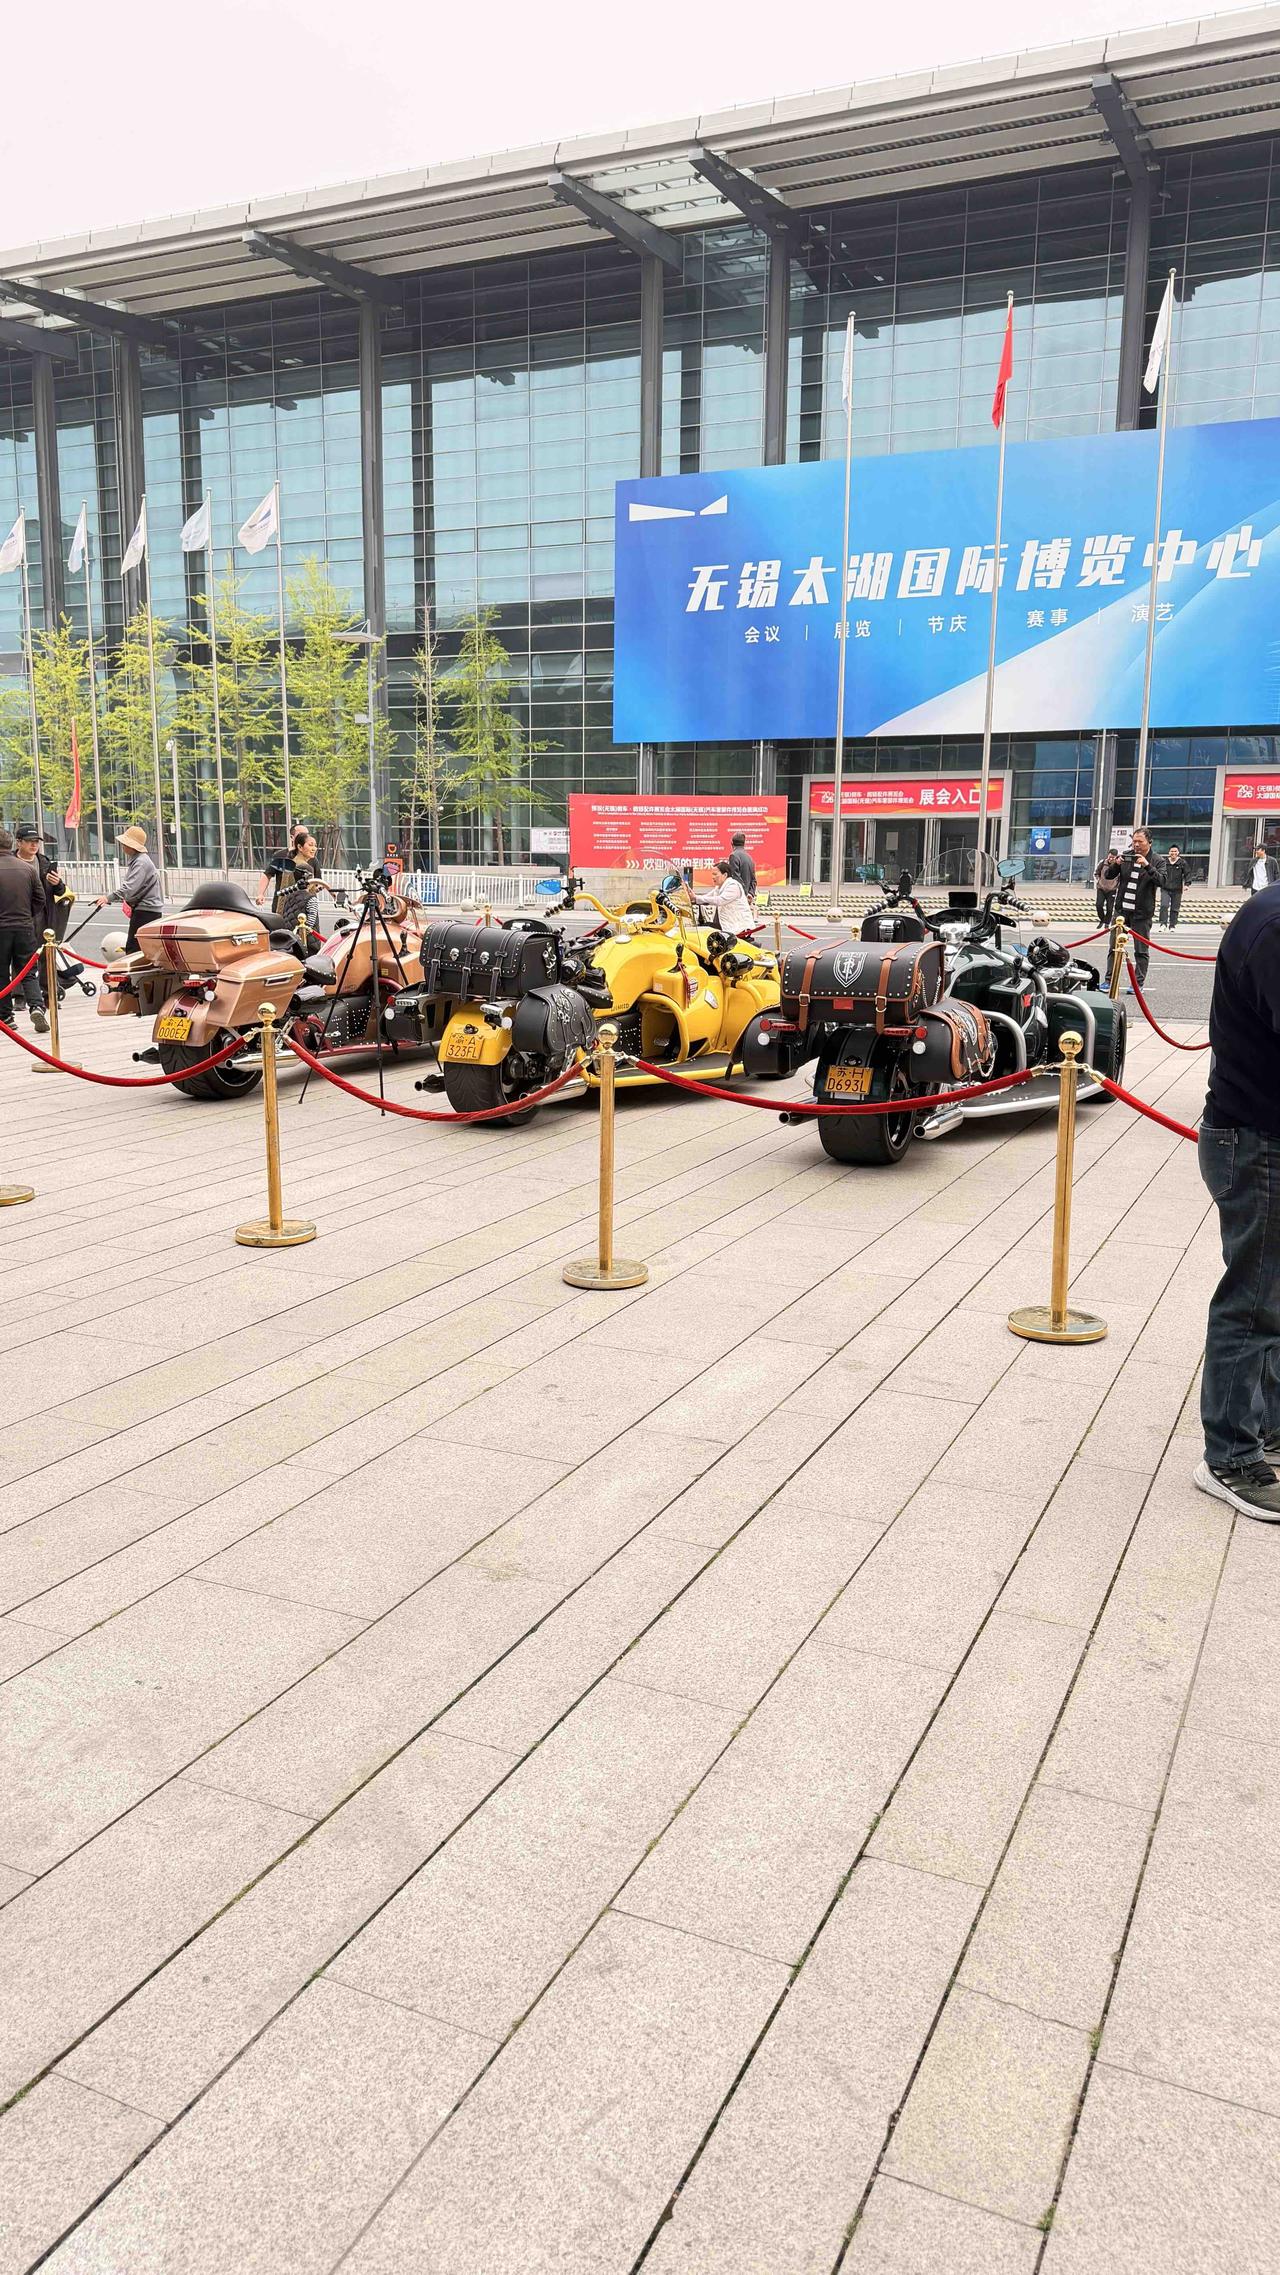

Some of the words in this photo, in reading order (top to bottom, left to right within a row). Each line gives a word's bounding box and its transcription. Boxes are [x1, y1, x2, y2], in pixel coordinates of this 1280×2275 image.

[684, 525, 1264, 613] 无锡太湖国际博览中心
[744, 625, 781, 644] 会议
[833, 619, 872, 639] 展览
[927, 614, 967, 634] 节庆
[1026, 608, 1069, 628] 赛事
[1130, 602, 1175, 623] 演艺
[918, 787, 981, 805] 展会入口
[158, 1027, 187, 1040] 000EZ
[447, 1044, 477, 1059] 323FL
[827, 1077, 867, 1093] D693L
